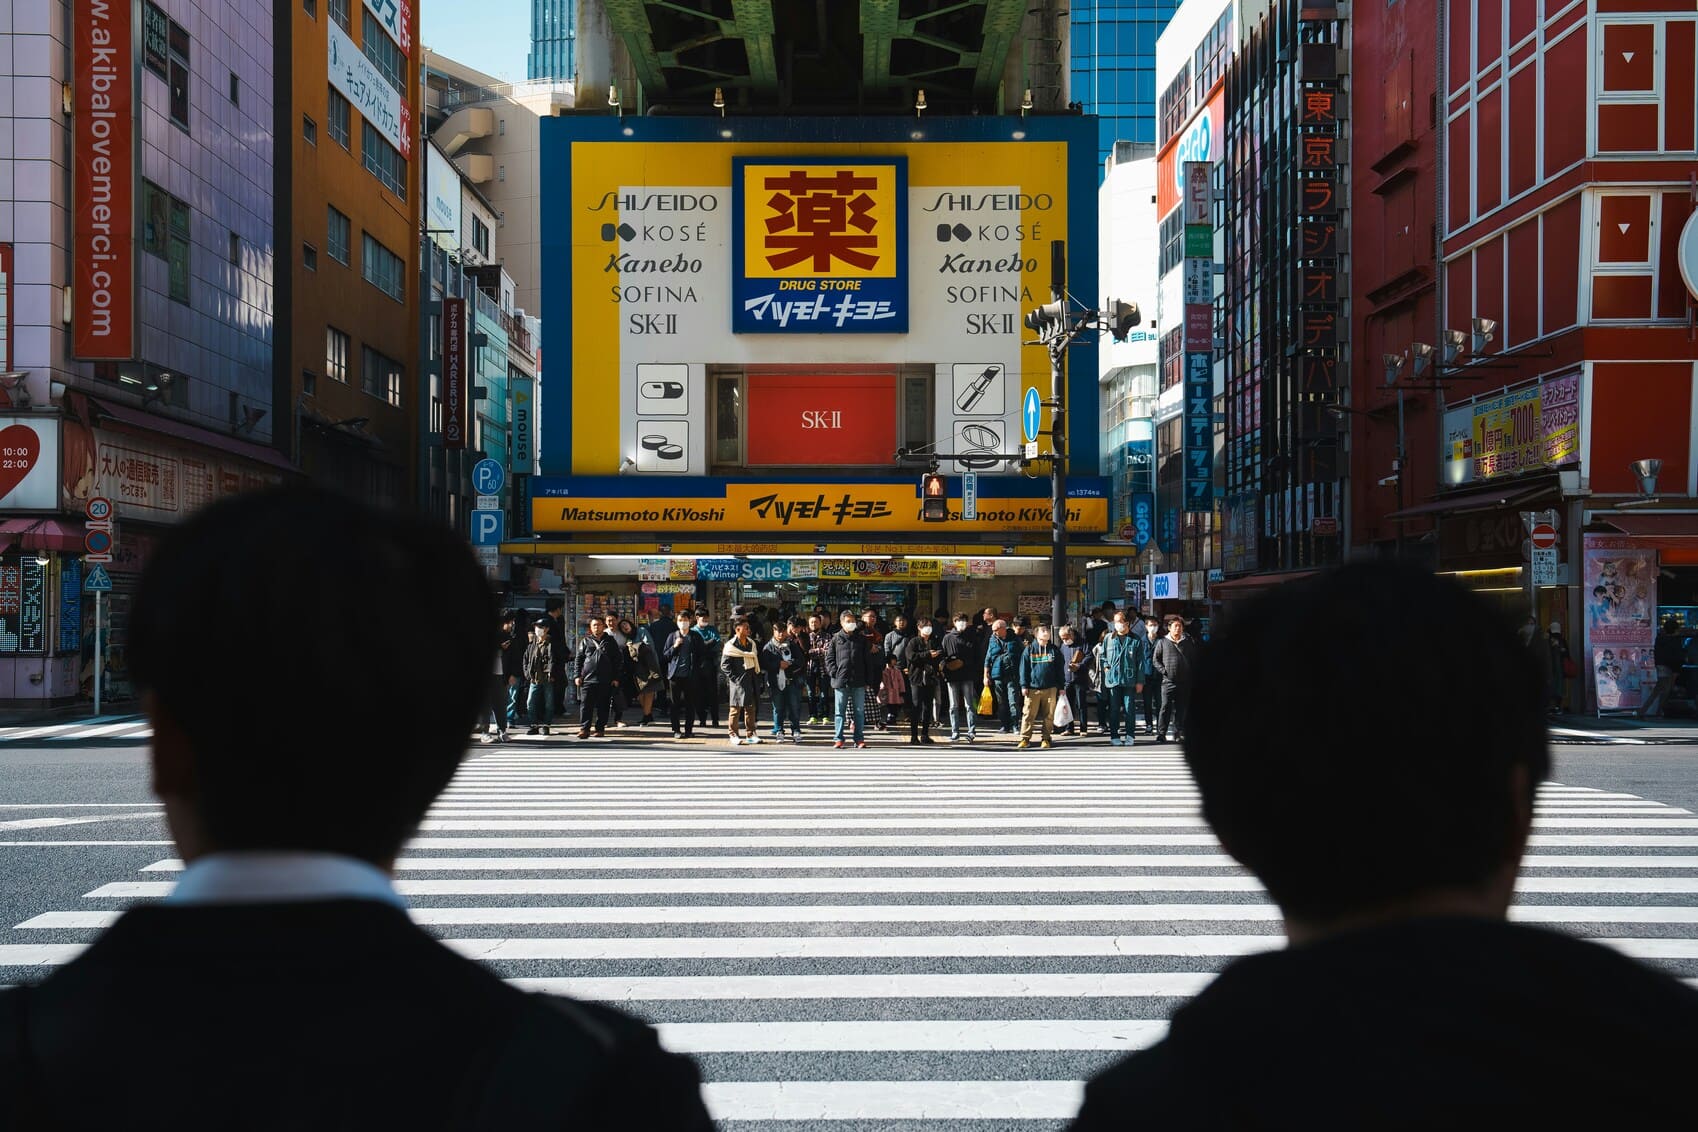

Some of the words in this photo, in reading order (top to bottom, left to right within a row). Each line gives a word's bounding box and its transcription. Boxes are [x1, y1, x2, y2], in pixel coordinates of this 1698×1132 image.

[346, 66, 399, 138] キュアメイドカフェ
[402, 121, 411, 154] 4F
[588, 192, 718, 211] SHISEIDO
[922, 192, 1053, 212] SHISEIDO
[643, 222, 706, 241] KOSÉ
[765, 171, 881, 273] 薬
[979, 221, 1042, 241] KOSÉ
[604, 253, 702, 273] Kanebo
[939, 253, 1038, 273] Kanebo
[611, 286, 697, 303] SOFINA
[779, 280, 816, 291] DRUG
[819, 280, 862, 291] STORE
[947, 286, 1033, 303] SOFINA
[745, 293, 897, 328] マツモトキヨシ
[630, 314, 678, 334] SK-II
[966, 314, 1015, 334] SK-II
[449, 355, 459, 423] HARERUYA
[801, 411, 842, 429] SK-II
[447, 425, 460, 441] 2
[517, 409, 527, 466] mouse
[3, 448, 28, 456] 10:00
[3, 460, 28, 468] 22:00
[101, 453, 160, 486] 大人の通信販売
[481, 468, 491, 490] P
[488, 480, 497, 490] 60
[92, 503, 107, 515] 20
[561, 508, 659, 521] Matsumoto
[662, 508, 725, 521] KiYoshi
[750, 494, 892, 525] マツモトキヨシ
[480, 514, 498, 543] P
[742, 563, 782, 578] Sale
